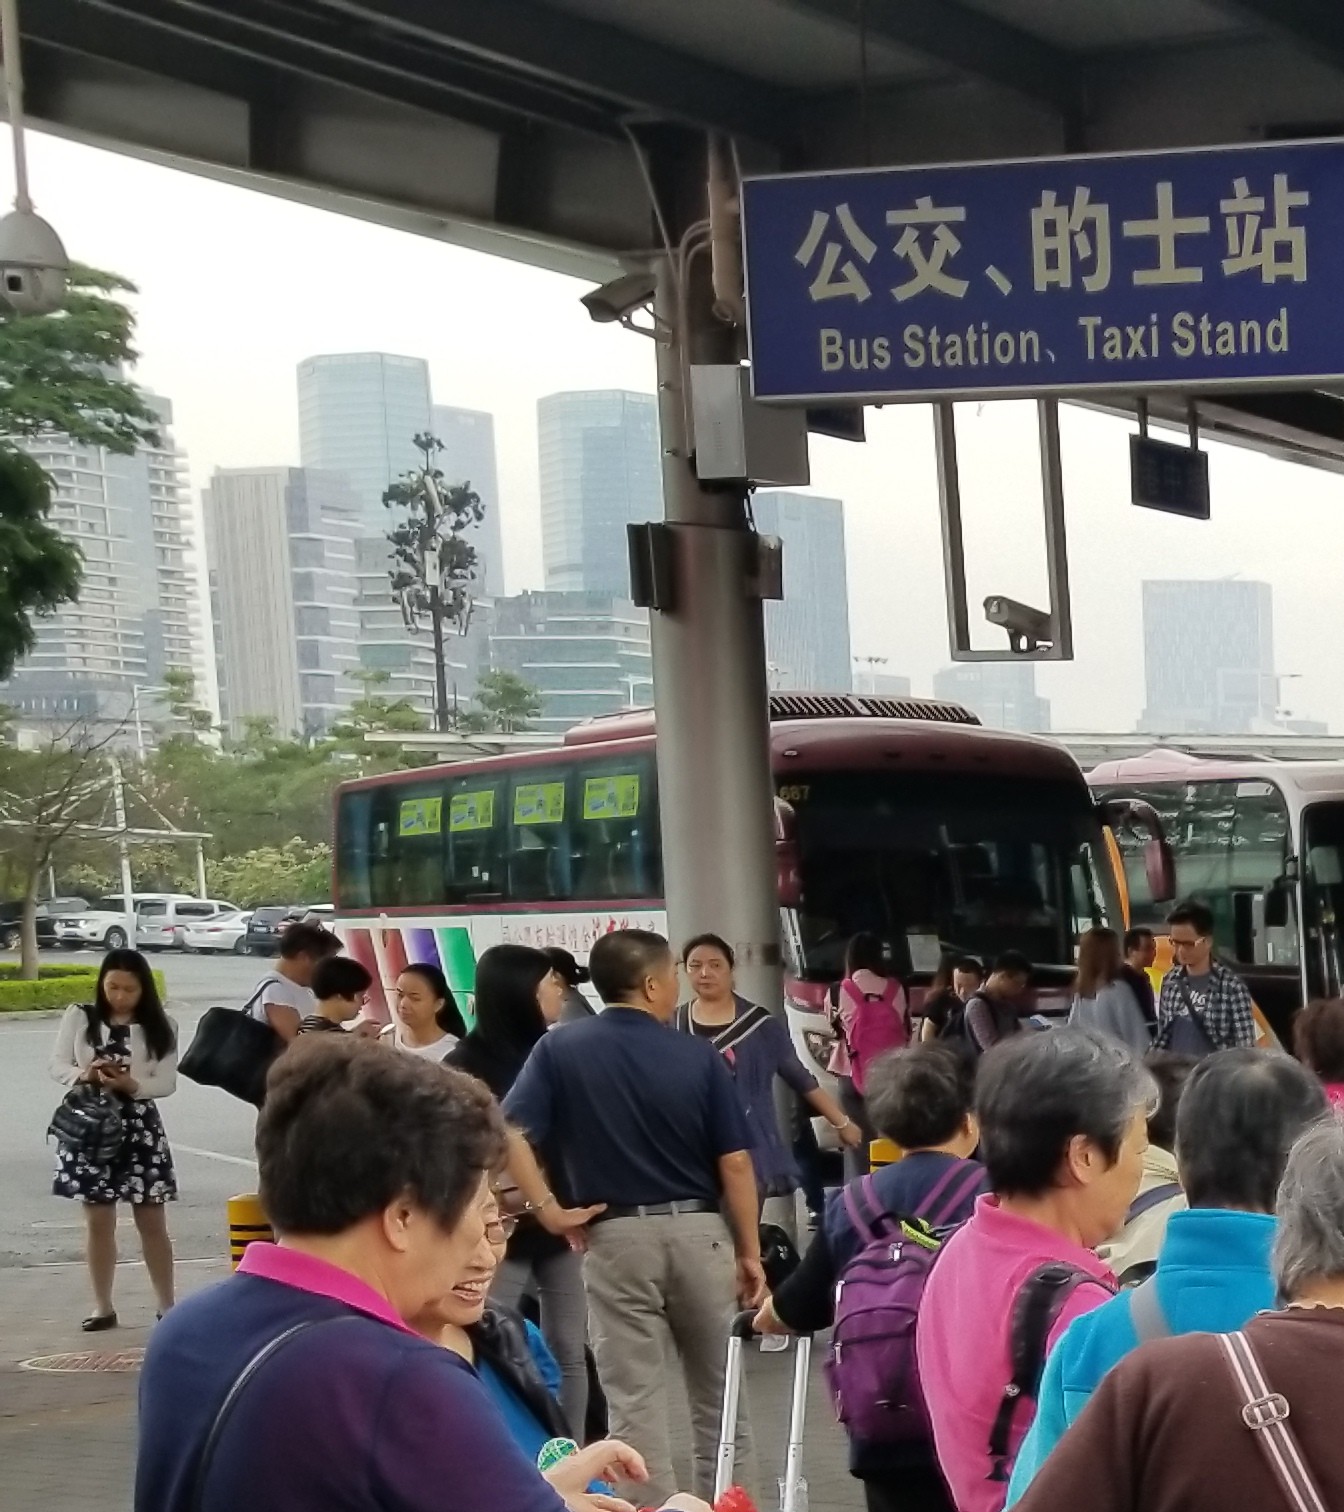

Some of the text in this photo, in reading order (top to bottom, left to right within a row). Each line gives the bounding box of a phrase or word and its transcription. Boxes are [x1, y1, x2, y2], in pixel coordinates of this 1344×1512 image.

[794, 173, 1309, 303] 公交、的士站
[820, 326, 891, 372] Bus
[1078, 314, 1159, 361] Taxi
[1171, 308, 1288, 359] Stand
